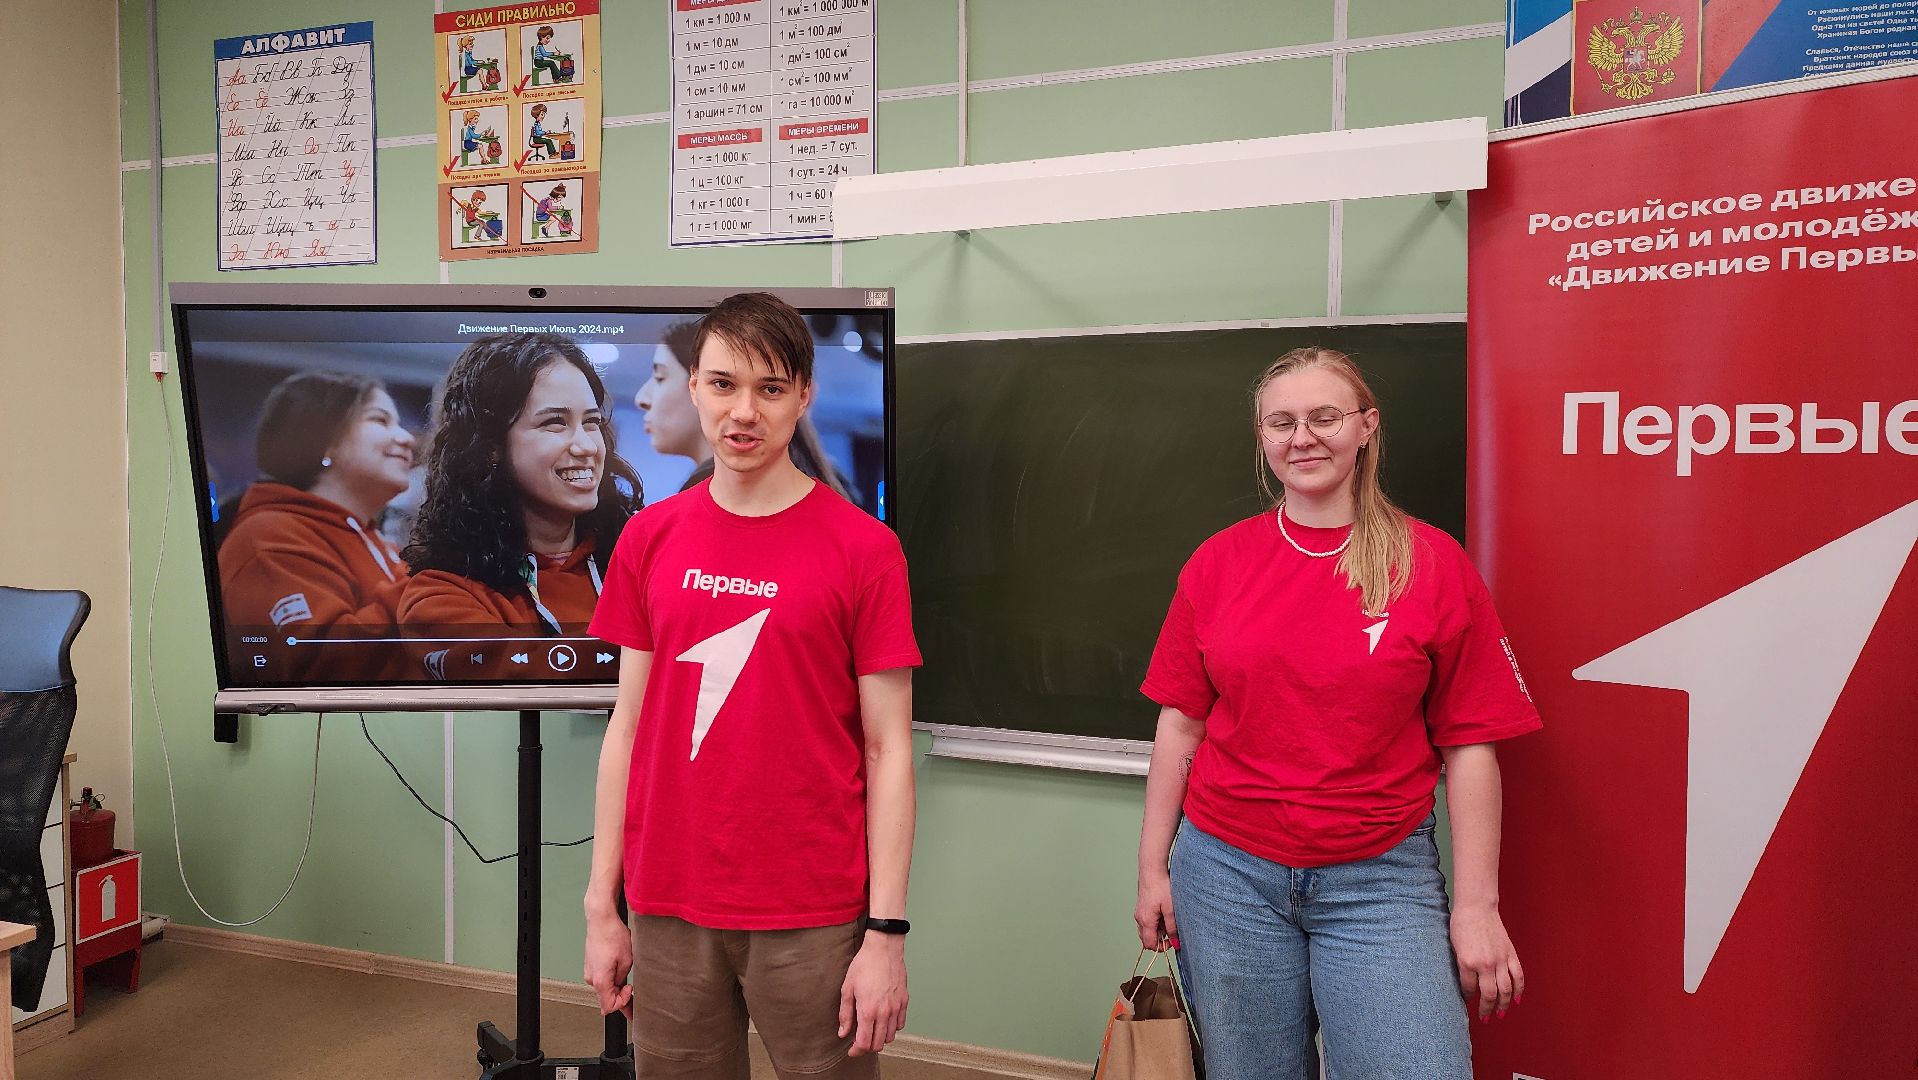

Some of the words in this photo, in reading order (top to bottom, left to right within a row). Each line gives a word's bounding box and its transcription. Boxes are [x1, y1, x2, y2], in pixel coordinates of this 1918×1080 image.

[780, 6, 784, 16] 1
[813, 2, 816, 12] 1
[1852, 3, 1878, 12] морей
[1892, 0, 1918, 8] поляр
[456, 11, 493, 28] СИДИ
[497, 1, 576, 23] ПРАВИЛЬНО
[686, 18, 690, 28] 1
[694, 19, 704, 28] км
[716, 14, 720, 24] 1
[744, 13, 750, 22] м
[1871, 10, 1894, 18] наши
[780, 30, 784, 40] 1
[808, 24, 824, 37] 100
[1812, 24, 1832, 32] Одна
[1817, 30, 1858, 39] Хранимая
[1886, 26, 1916, 34] родная
[241, 27, 346, 55] АЛФАВИТ
[686, 41, 690, 51] 1
[694, 42, 700, 50] м
[712, 37, 722, 48] 10
[724, 38, 738, 48] дм
[814, 48, 830, 60] 100
[687, 64, 691, 74] 1
[694, 65, 706, 76] дм
[719, 59, 728, 70] 10
[732, 60, 744, 70] см
[814, 72, 830, 84] 100
[687, 86, 691, 96] 1
[694, 88, 706, 96] см
[718, 82, 728, 94] 10
[732, 83, 746, 92] мм
[788, 101, 798, 110] га
[810, 96, 820, 107] 10
[687, 109, 691, 119] 1
[694, 108, 724, 120] аршин
[736, 104, 746, 114] 71
[750, 104, 762, 114] см
[788, 126, 814, 136] МЕРЫ
[816, 122, 859, 134] ВРЕМЕНИ
[690, 136, 716, 144] МЕРЫ
[790, 144, 794, 154] 1
[798, 144, 818, 156] нед.
[830, 140, 836, 152] 7
[840, 140, 858, 154] сут.
[691, 154, 695, 164] 1
[715, 152, 718, 164] 1
[789, 167, 794, 178] 1
[797, 168, 816, 180] сут.
[828, 164, 840, 176] 24
[842, 166, 848, 174] ч
[690, 176, 694, 188] 1
[698, 178, 704, 188] ц
[716, 174, 732, 186] 100
[734, 176, 744, 184] кг
[789, 190, 793, 200] 1
[797, 192, 802, 200] ч
[814, 188, 826, 200] 60
[690, 200, 694, 210] 1
[698, 200, 708, 210] кг
[719, 198, 722, 208] 1
[746, 198, 750, 206] г
[1528, 191, 1763, 235] Российское
[1770, 178, 1918, 210] движе
[690, 222, 694, 232] 1
[698, 224, 702, 232] г
[713, 220, 718, 230] 1
[740, 222, 752, 230] мг
[789, 214, 793, 224] 1
[798, 214, 817, 224] мин
[1566, 228, 1680, 262] детей
[1689, 227, 1712, 248] и
[1721, 208, 1918, 243] молодёж
[1548, 254, 1770, 292] «Движение
[458, 324, 508, 334] Движение
[510, 324, 548, 334] Первых
[549, 324, 576, 334] Июль
[578, 325, 624, 336] 2024.mp4
[1562, 391, 1918, 477] Первые
[682, 568, 778, 598] Первые
